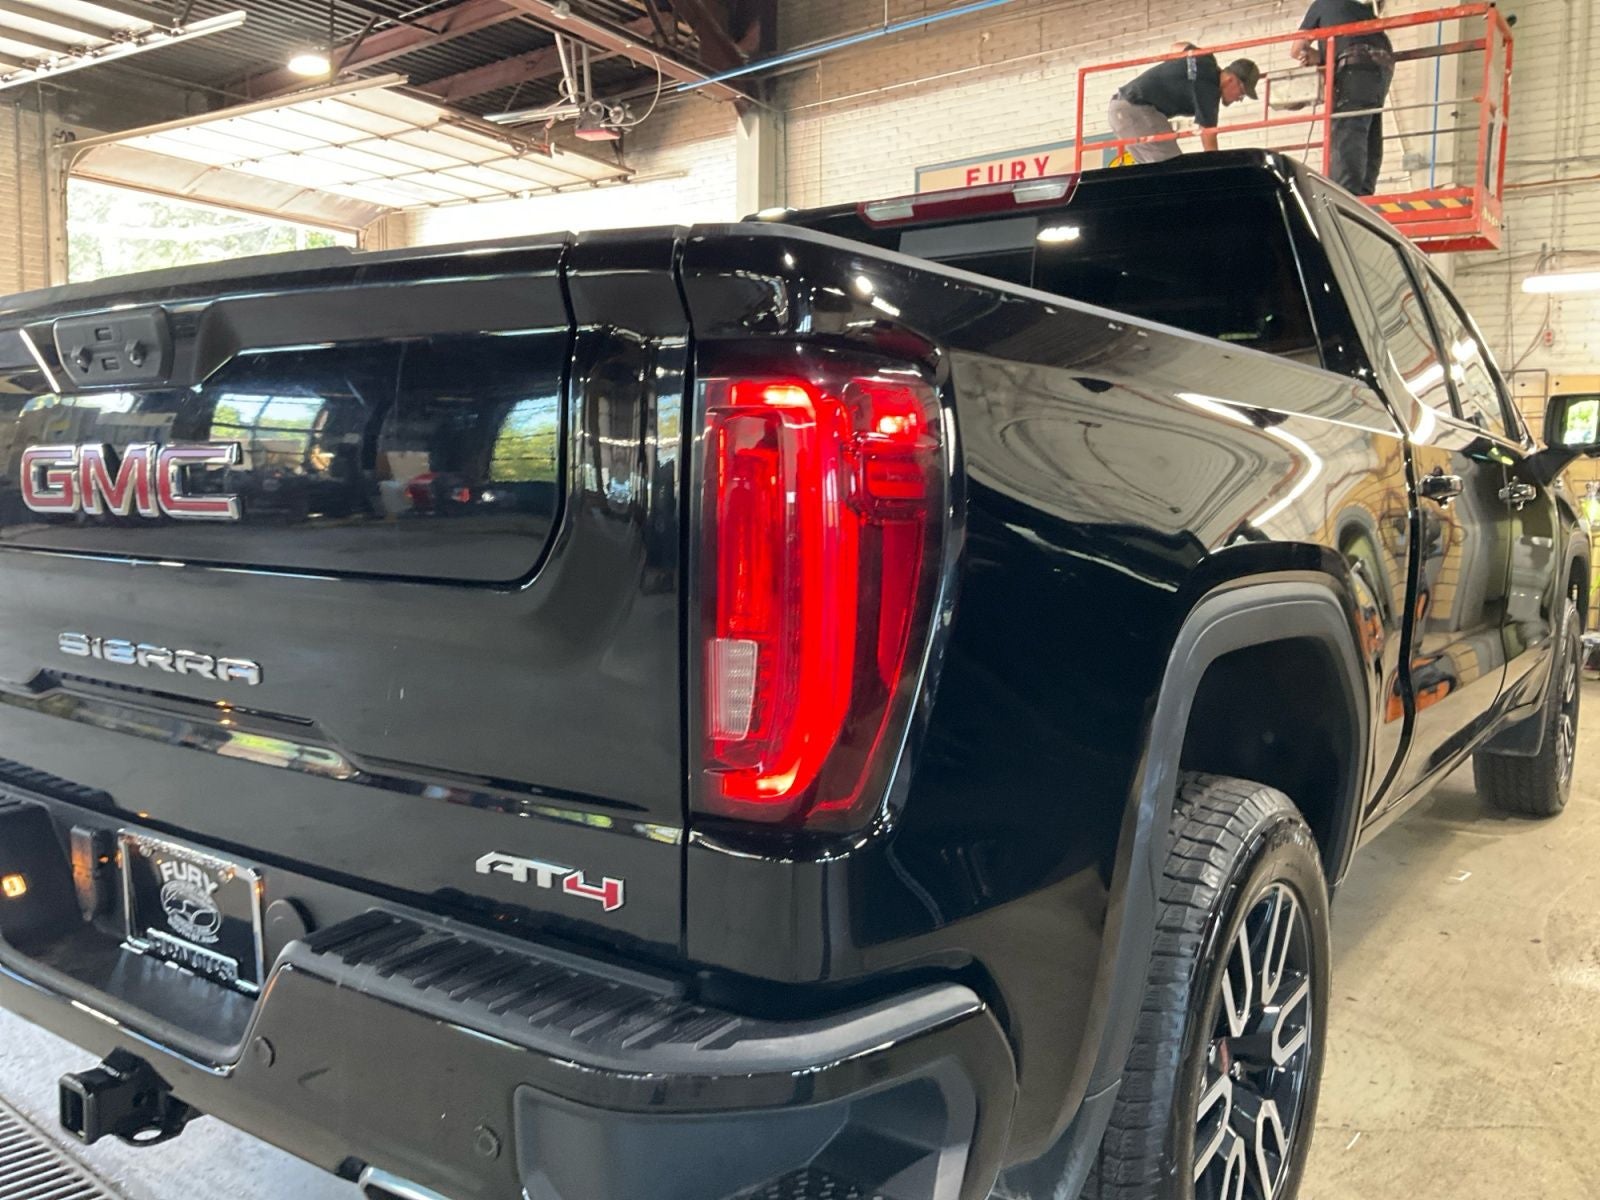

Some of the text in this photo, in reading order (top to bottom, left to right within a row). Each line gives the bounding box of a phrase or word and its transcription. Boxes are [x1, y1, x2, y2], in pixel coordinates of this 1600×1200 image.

[966, 156, 1049, 188] FURY
[21, 441, 242, 520] GMC
[58, 632, 264, 685] SIERRA
[160, 860, 218, 894] FURY
[475, 851, 624, 911] AT4
